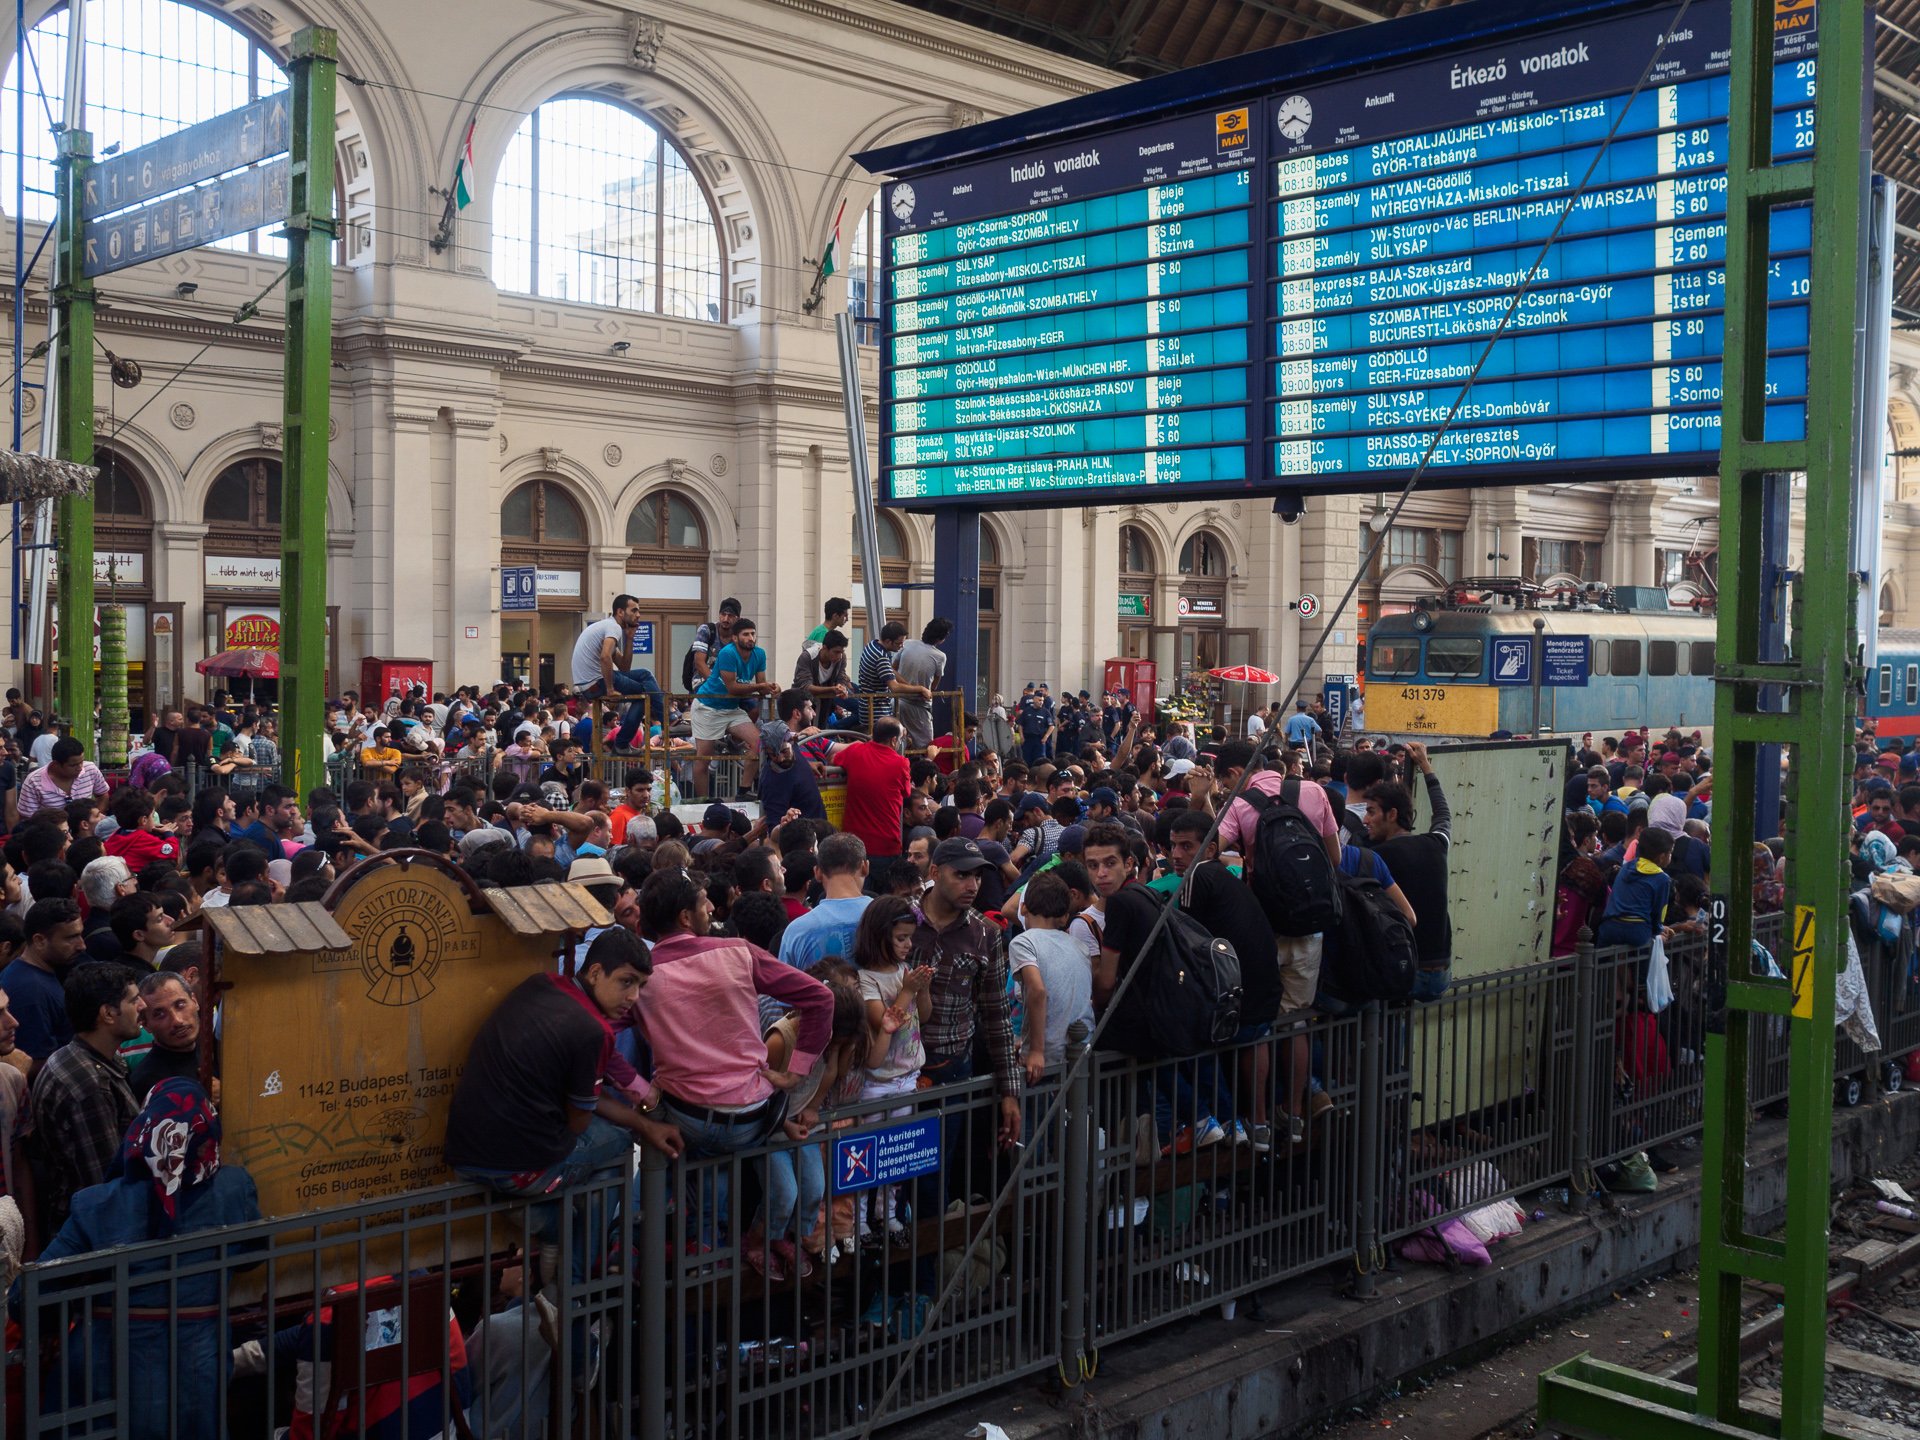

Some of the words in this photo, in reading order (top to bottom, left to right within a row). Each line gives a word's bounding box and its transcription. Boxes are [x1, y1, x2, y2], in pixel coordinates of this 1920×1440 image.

[1775, 14, 1810, 31] MÁV
[1657, 29, 1693, 46] Arivals
[1784, 35, 1806, 45] Késés
[1451, 58, 1507, 90] Érkező
[1520, 42, 1589, 74] vonatok
[1656, 60, 1680, 72] Vágány
[1705, 60, 1729, 70] Hinweis
[1671, 69, 1686, 78] Track
[1365, 92, 1395, 108] Ankunft
[1480, 95, 1506, 107] HONNAN
[1284, 159, 1313, 174] 08:00
[1316, 154, 1349, 170] sebes
[1796, 60, 1815, 78] 20
[1222, 134, 1245, 148] MÁV
[1139, 142, 1174, 156] Departures
[142, 162, 152, 188] 6
[161, 150, 221, 183] vágányokhoz
[1011, 160, 1045, 182] Induló
[1054, 150, 1100, 174] vonatok
[1283, 200, 1312, 216] 08:25
[1315, 192, 1360, 210] személy
[1795, 110, 1814, 127] 15
[1160, 185, 1184, 201] eleje
[1237, 171, 1249, 185] 15
[1284, 176, 1313, 192] 08:19
[1316, 171, 1347, 190] gyors
[1315, 214, 1328, 228] IC
[1677, 150, 1715, 168] Avas
[1795, 130, 1814, 148] 20
[952, 184, 972, 195] Abfahrt
[1161, 202, 1184, 217] vége
[1160, 239, 1194, 253] Szinva
[1283, 240, 1312, 255] 08:35
[1315, 238, 1329, 251] EN
[1284, 258, 1312, 273] 08:40
[1315, 251, 1360, 268] személy
[917, 265, 949, 280] személy
[1314, 275, 1365, 292] expressz
[1370, 258, 1471, 285] BAJA-Szekszárd
[917, 299, 949, 313] személy
[1283, 298, 1312, 313] 08:45
[1314, 293, 1353, 308] zónázó
[918, 314, 939, 327] gyors
[1282, 339, 1311, 353] 08:50
[1314, 336, 1328, 349] EN
[1791, 279, 1810, 295] 10
[1282, 321, 1310, 336] 08:49
[1313, 320, 1326, 333] IC
[917, 333, 948, 346] személy
[918, 348, 939, 361] gyors
[1159, 353, 1194, 368] RailJet
[917, 367, 948, 380] személy
[1282, 362, 1310, 376] 08:55
[1313, 358, 1357, 374] személy
[1159, 377, 1182, 390] eleje
[1282, 379, 1309, 392] 09:00
[1313, 377, 1344, 394] gyors
[1159, 393, 1182, 407] vége
[1281, 402, 1309, 416] 09:10
[1312, 399, 1357, 414] személy
[1281, 419, 1309, 432] 09:14
[1312, 418, 1325, 430] IC
[916, 436, 943, 447] zónázó
[1280, 444, 1308, 456] 09:15
[1311, 442, 1324, 454] IC
[917, 449, 948, 462] személy
[1158, 452, 1180, 465] eleje
[1281, 459, 1309, 473] 09:19
[1312, 458, 1343, 473] gyors
[955, 479, 1005, 492] aha-BERLIN
[240, 567, 258, 576] mint
[260, 570, 273, 581] egy
[236, 620, 271, 633] PAIN
[1401, 688, 1420, 700] 431
[1423, 689, 1445, 701] 379
[445, 939, 477, 952] PARK
[317, 950, 360, 964] MAGYAR
[299, 1081, 335, 1098] 1142
[340, 1072, 413, 1093] Budapest,
[418, 1066, 450, 1082] Tatai
[319, 1100, 340, 1113] Tel:
[345, 1090, 411, 1109] 450-14-97,
[879, 1135, 885, 1145] A
[889, 1128, 925, 1143] kerítésen
[879, 1140, 914, 1156] átmászni
[878, 1146, 938, 1168] balesetveszélyes
[878, 1170, 887, 1180] és
[890, 1165, 907, 1177] tilos!
[296, 1183, 328, 1199] 1056
[332, 1172, 396, 1193] Budapest,
[400, 1162, 447, 1182] Belgrád
